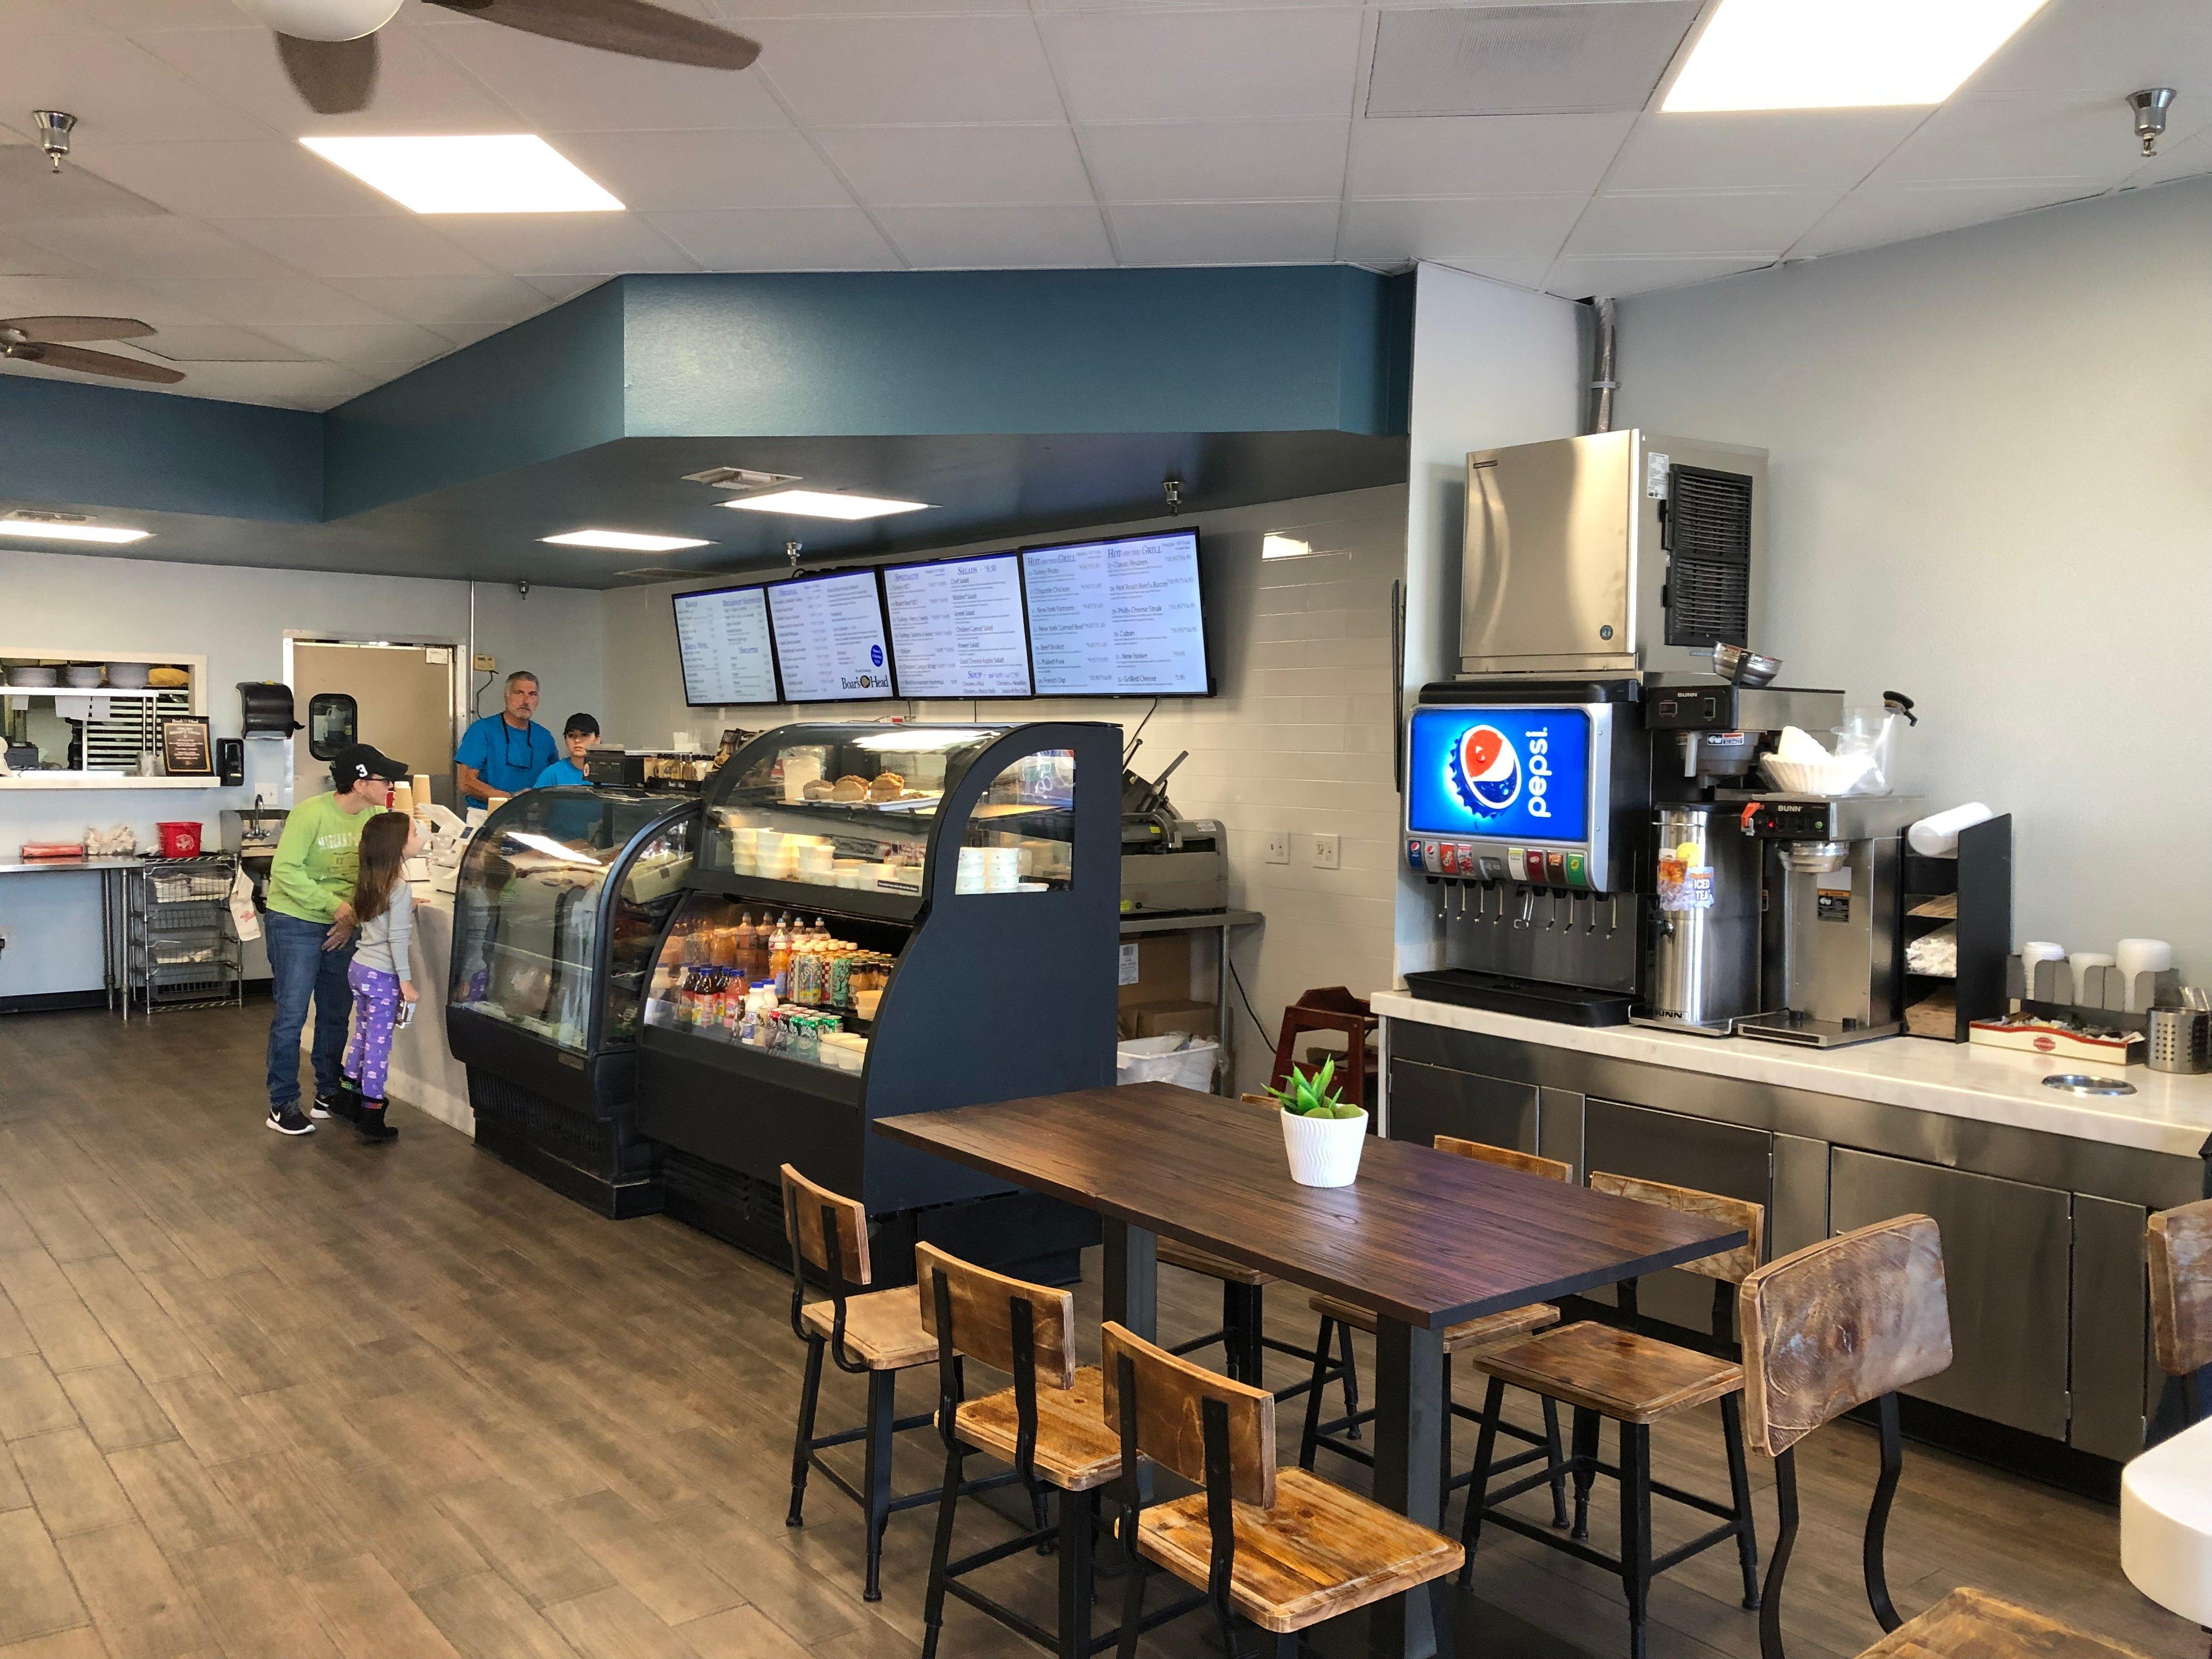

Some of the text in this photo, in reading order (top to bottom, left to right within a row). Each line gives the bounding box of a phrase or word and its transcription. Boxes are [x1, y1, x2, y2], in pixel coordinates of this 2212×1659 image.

[1108, 549, 1121, 558] HOT
[1142, 545, 1163, 554] GRILL
[1058, 554, 1076, 563] GRILL
[841, 674, 889, 689] Boar's Head
[356, 764, 368, 777] 3
[1525, 731, 1553, 817] pepsi
[1694, 879, 1710, 889] ICED
[1695, 889, 1708, 900] TEA
